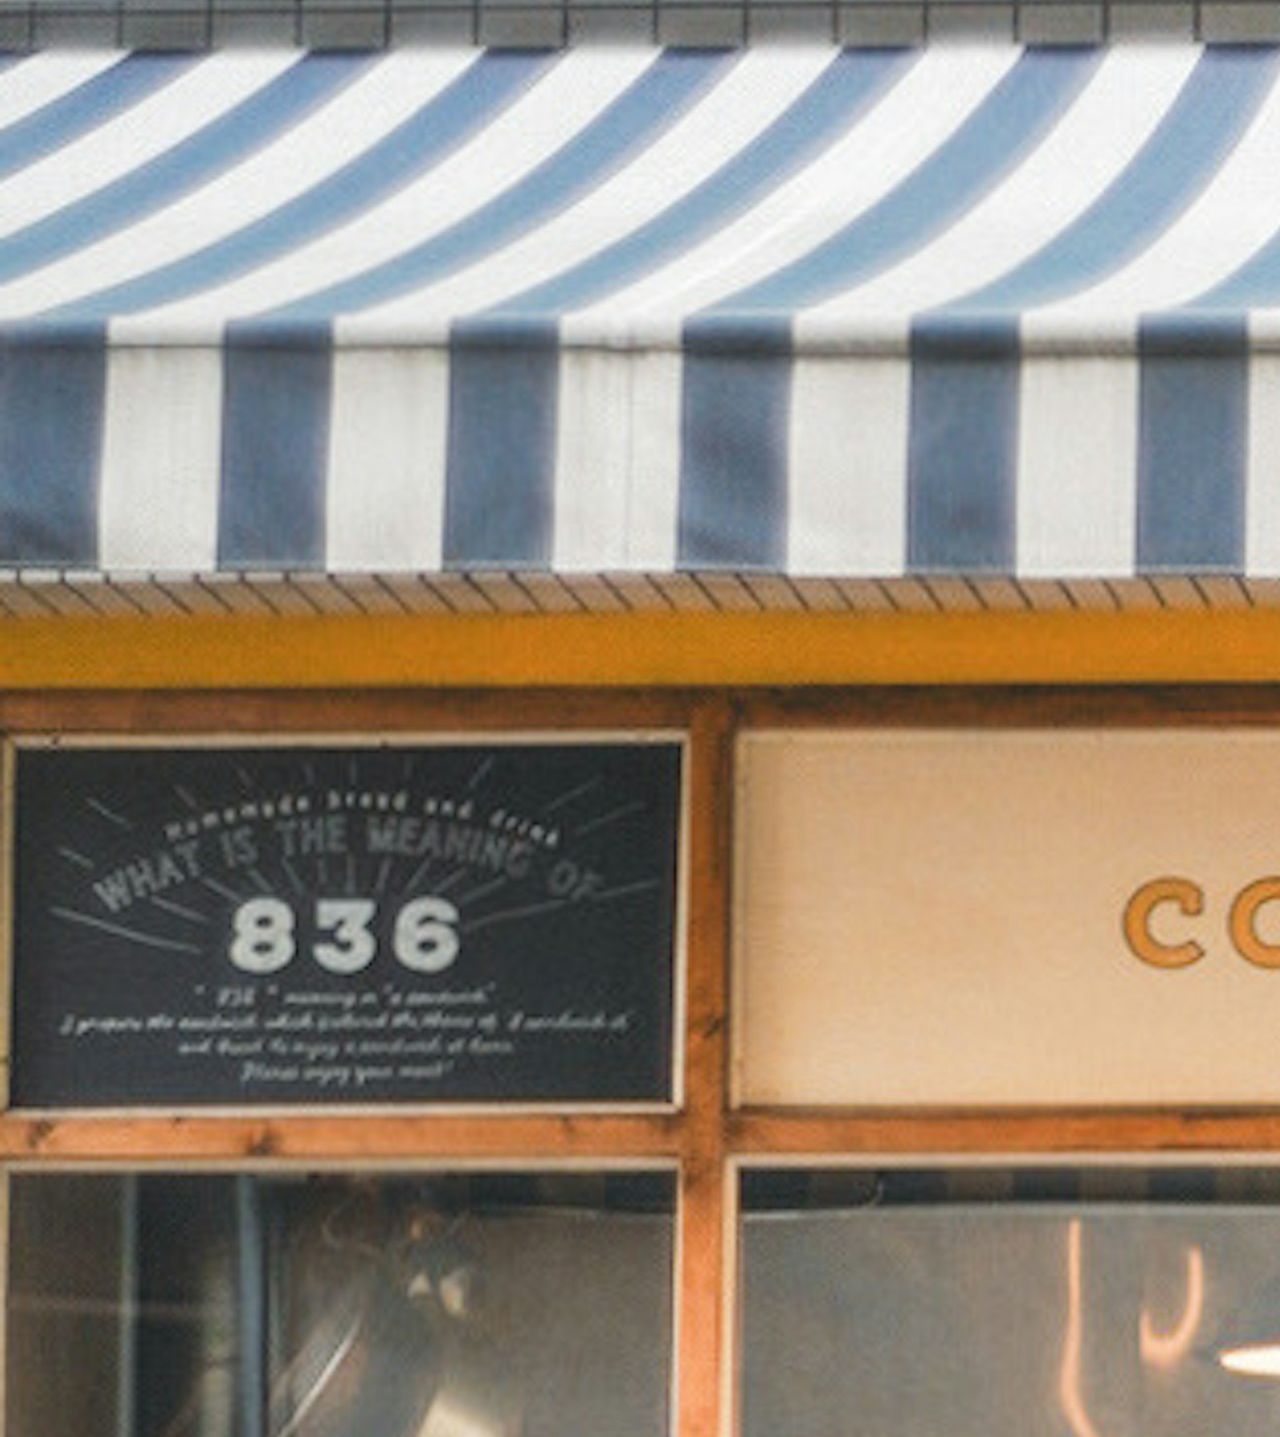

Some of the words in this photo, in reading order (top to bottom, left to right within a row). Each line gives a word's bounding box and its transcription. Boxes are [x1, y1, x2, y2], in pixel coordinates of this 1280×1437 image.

[92, 838, 200, 914] WHAT
[220, 825, 258, 868] IS
[275, 815, 348, 857] THE
[366, 814, 532, 879] MEANING
[229, 896, 461, 974] 836
